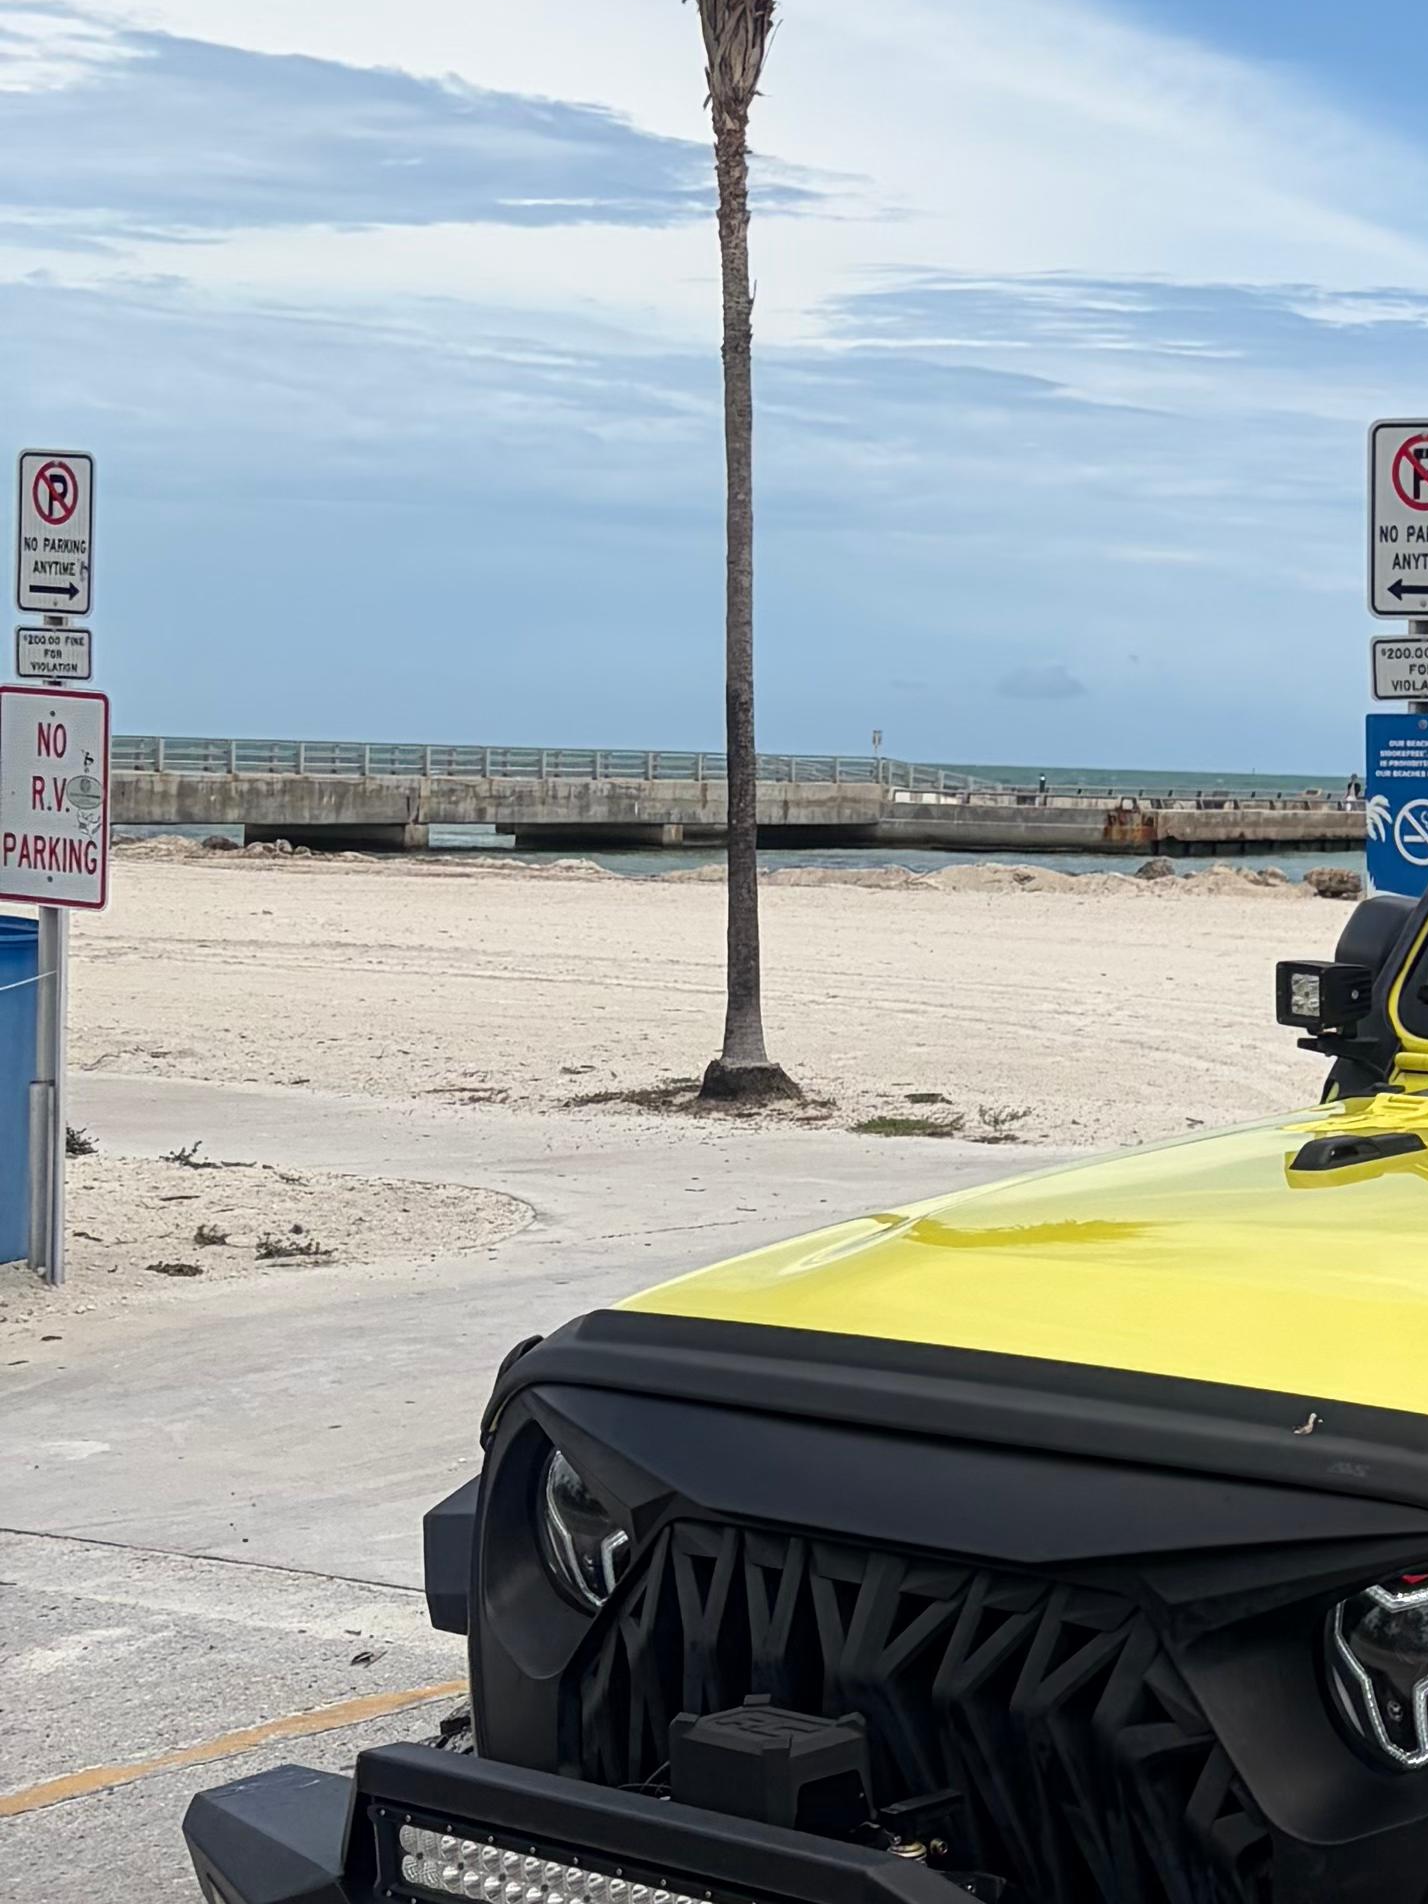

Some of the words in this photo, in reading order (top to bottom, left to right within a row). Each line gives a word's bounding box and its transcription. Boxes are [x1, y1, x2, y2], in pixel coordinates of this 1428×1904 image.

[1379, 525, 1399, 543] NO
[24, 537, 38, 551] NO
[43, 538, 86, 554] PARKING
[33, 560, 76, 577] ANYTIME
[44, 648, 62, 659] FOR
[30, 661, 77, 672] VIOLATION
[37, 722, 67, 758] NO
[32, 776, 70, 813] R.V.
[3, 832, 98, 875] PARKING
